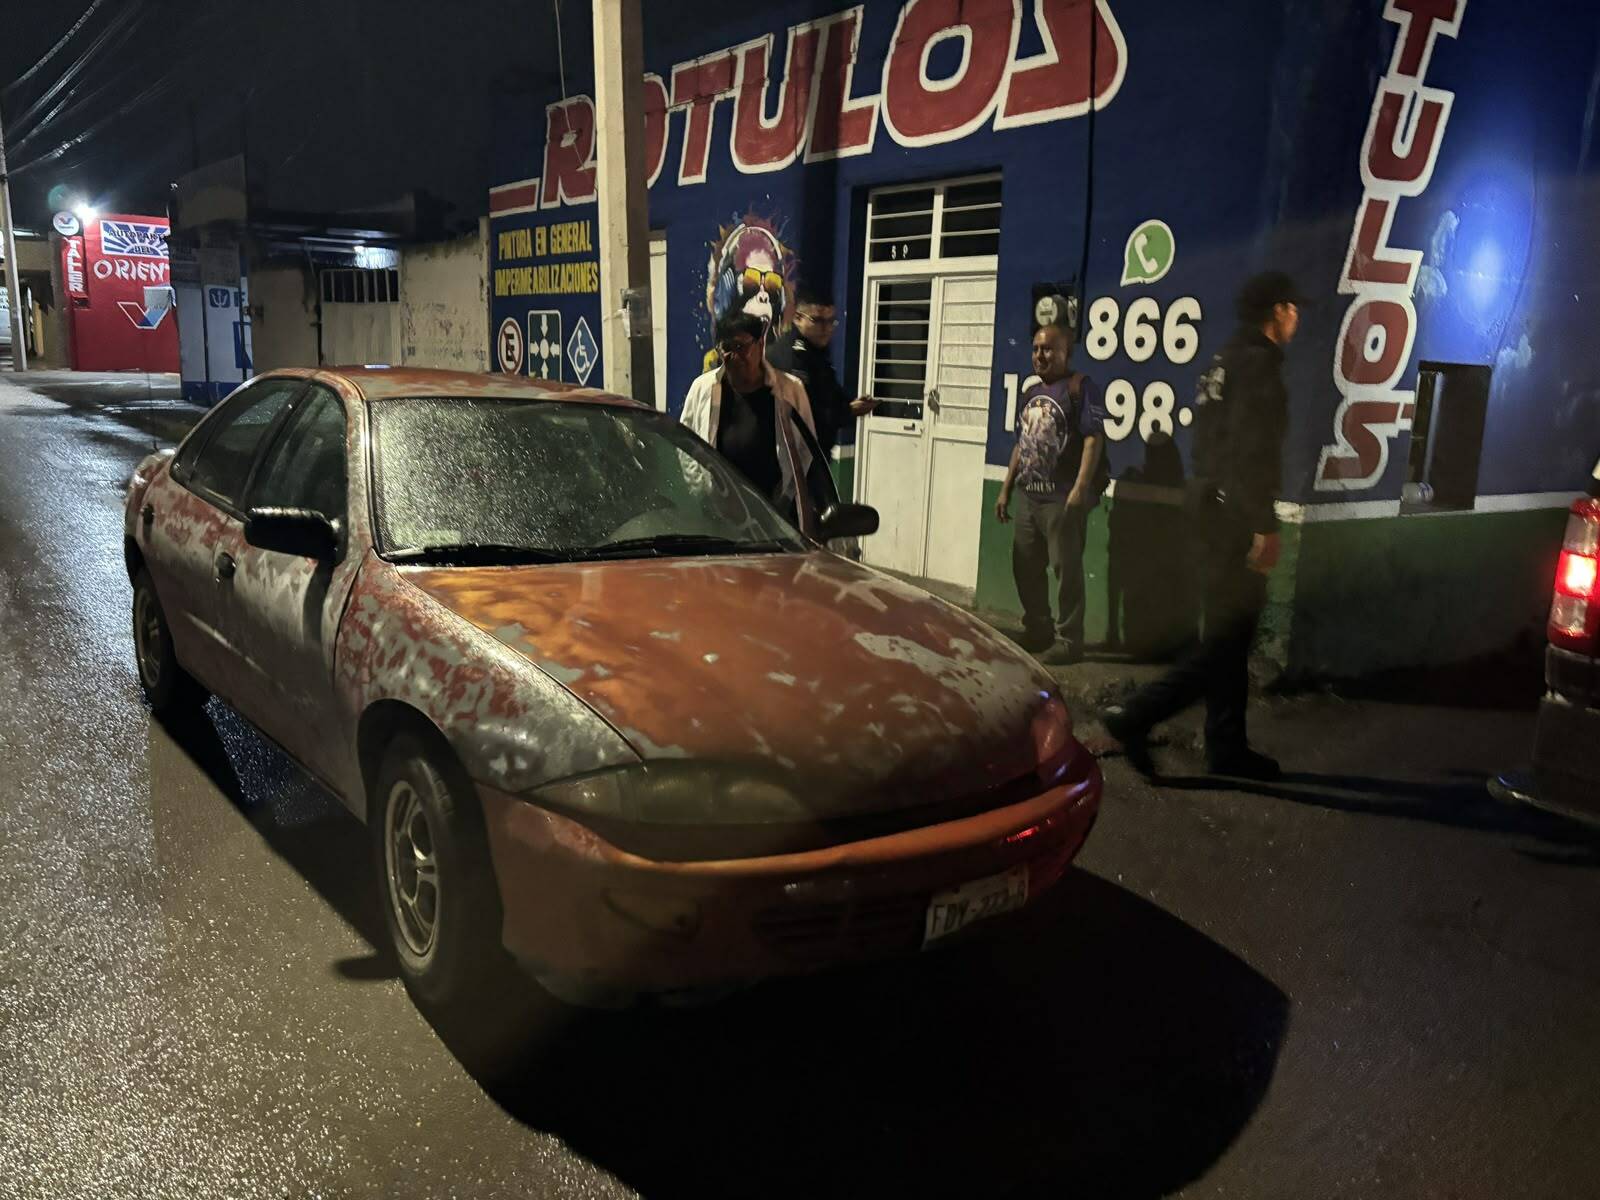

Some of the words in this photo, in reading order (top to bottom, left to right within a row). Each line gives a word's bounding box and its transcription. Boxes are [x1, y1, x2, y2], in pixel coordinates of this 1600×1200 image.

[67, 239, 84, 292] TALLER
[499, 228, 532, 260] PINTURA
[535, 226, 547, 256] EN
[550, 219, 592, 254] GENERAL
[494, 261, 599, 296] IMPERMEABILIZACIONES
[1085, 296, 1203, 365] 866
[1003, 372, 1042, 434] 1
